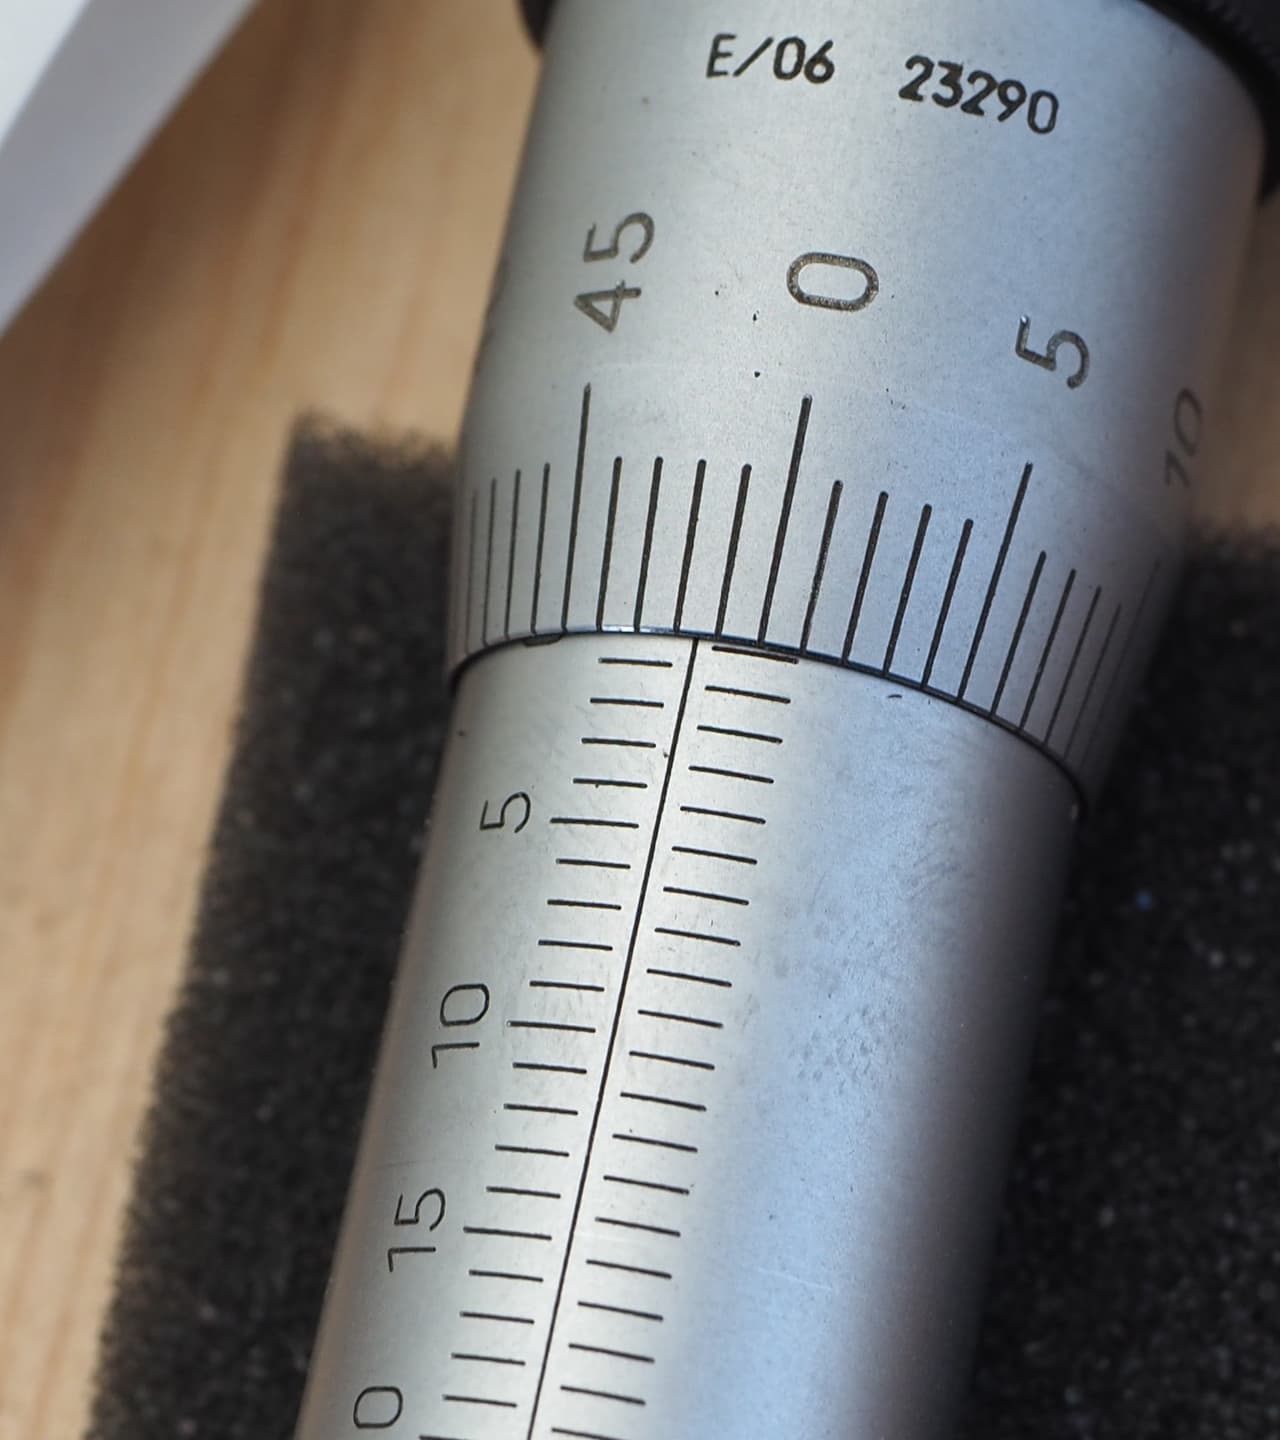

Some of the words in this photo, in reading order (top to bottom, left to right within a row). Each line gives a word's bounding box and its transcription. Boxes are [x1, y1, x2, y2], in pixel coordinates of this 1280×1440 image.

[705, 33, 836, 85] E/06
[897, 55, 1060, 135] 23290
[573, 211, 655, 333] 45
[787, 252, 880, 312] 0
[1015, 315, 1091, 390] 5
[1164, 387, 1203, 490] 10
[479, 791, 532, 833] 5
[431, 983, 490, 1068] 10
[387, 1187, 446, 1272] 15
